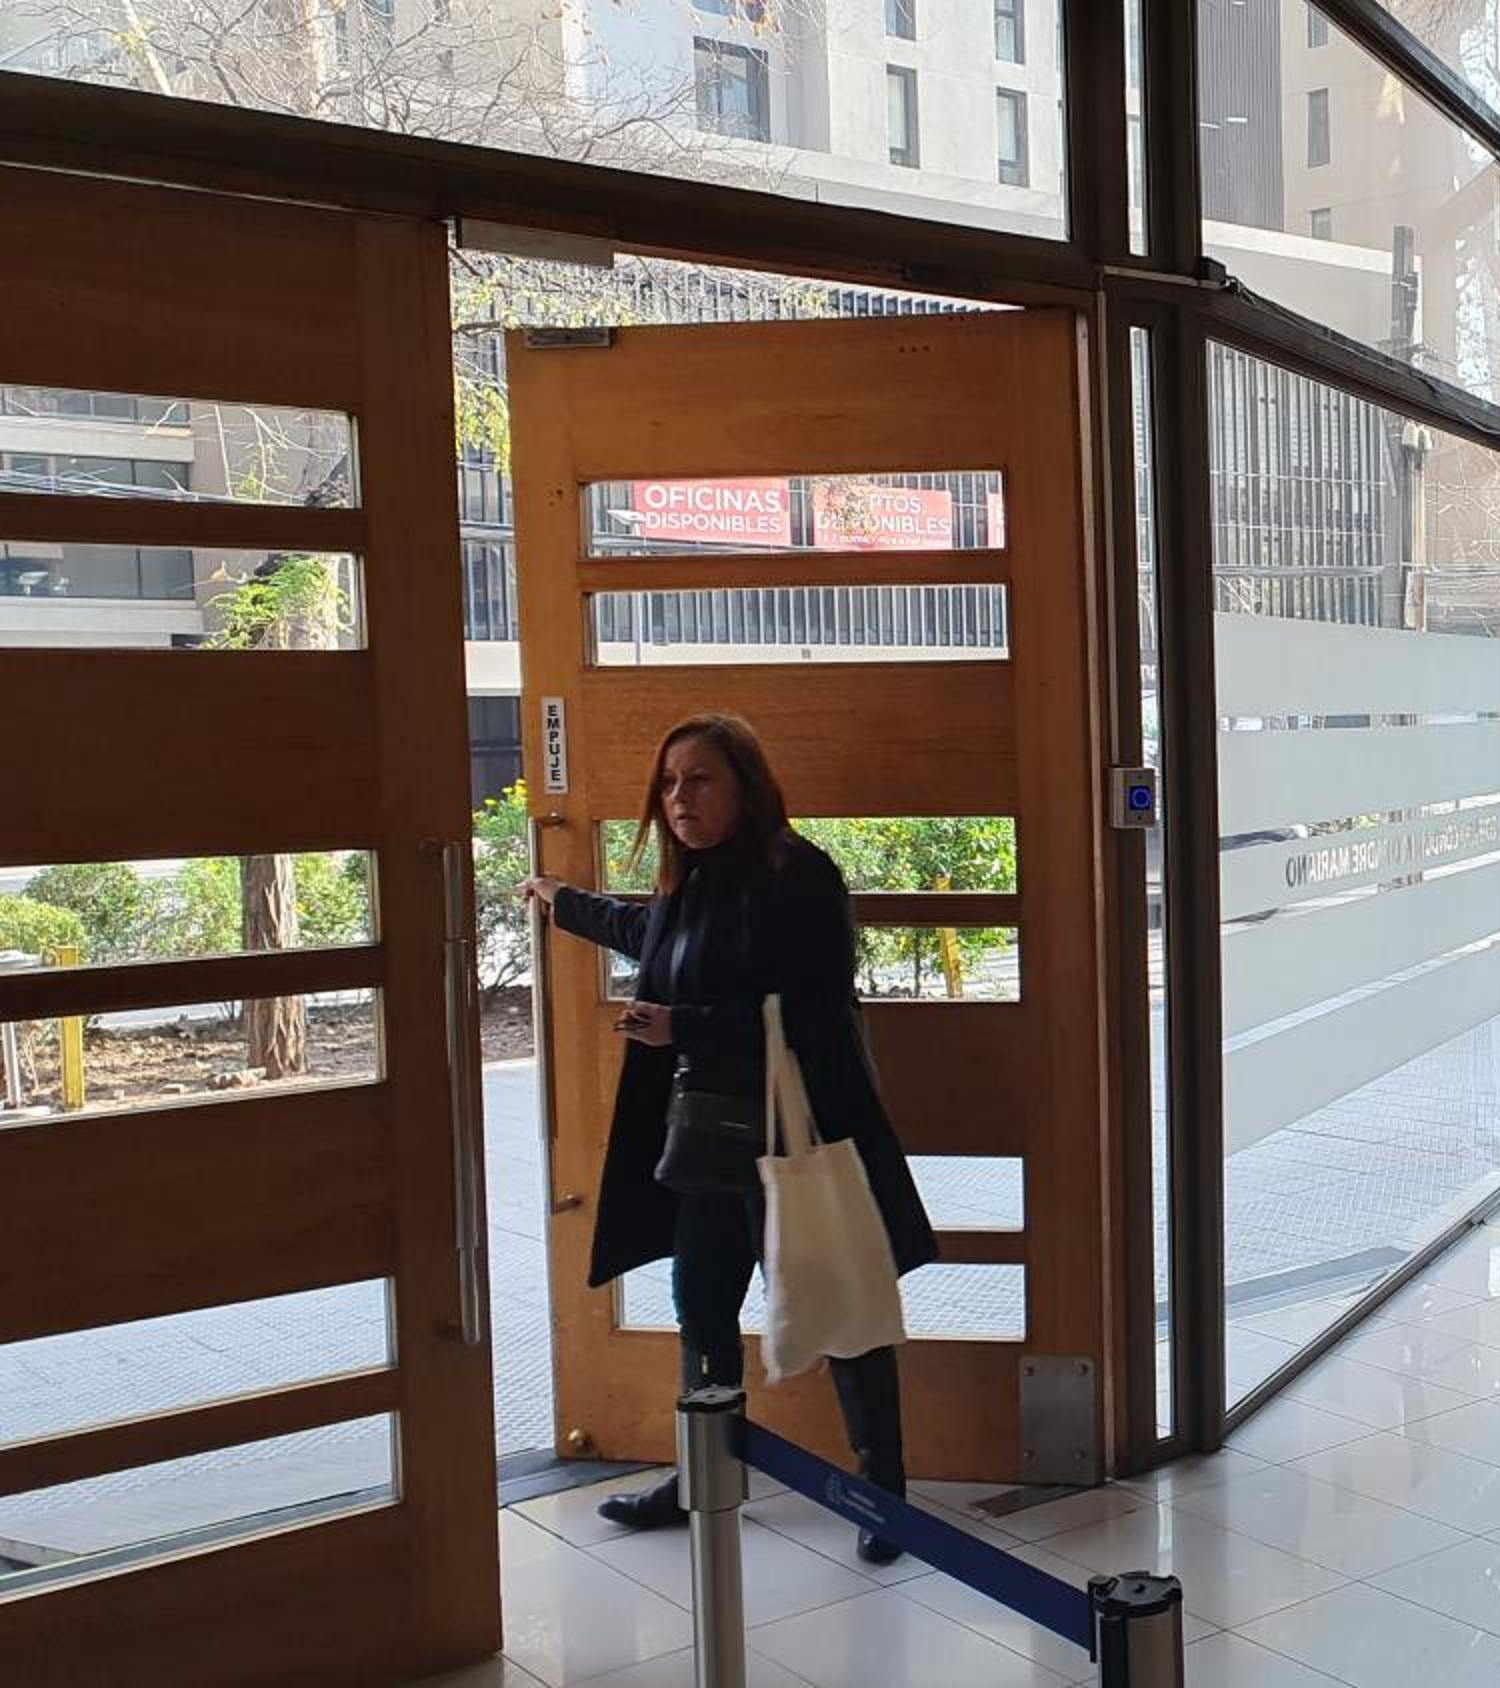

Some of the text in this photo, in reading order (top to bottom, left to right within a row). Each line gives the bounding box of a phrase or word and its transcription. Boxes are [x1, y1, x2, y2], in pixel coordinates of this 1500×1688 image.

[644, 484, 782, 513] OFICINAS
[645, 512, 782, 533] DISPONIBLES
[815, 511, 951, 535] DONIBLES
[546, 704, 561, 781] EMPUJE
